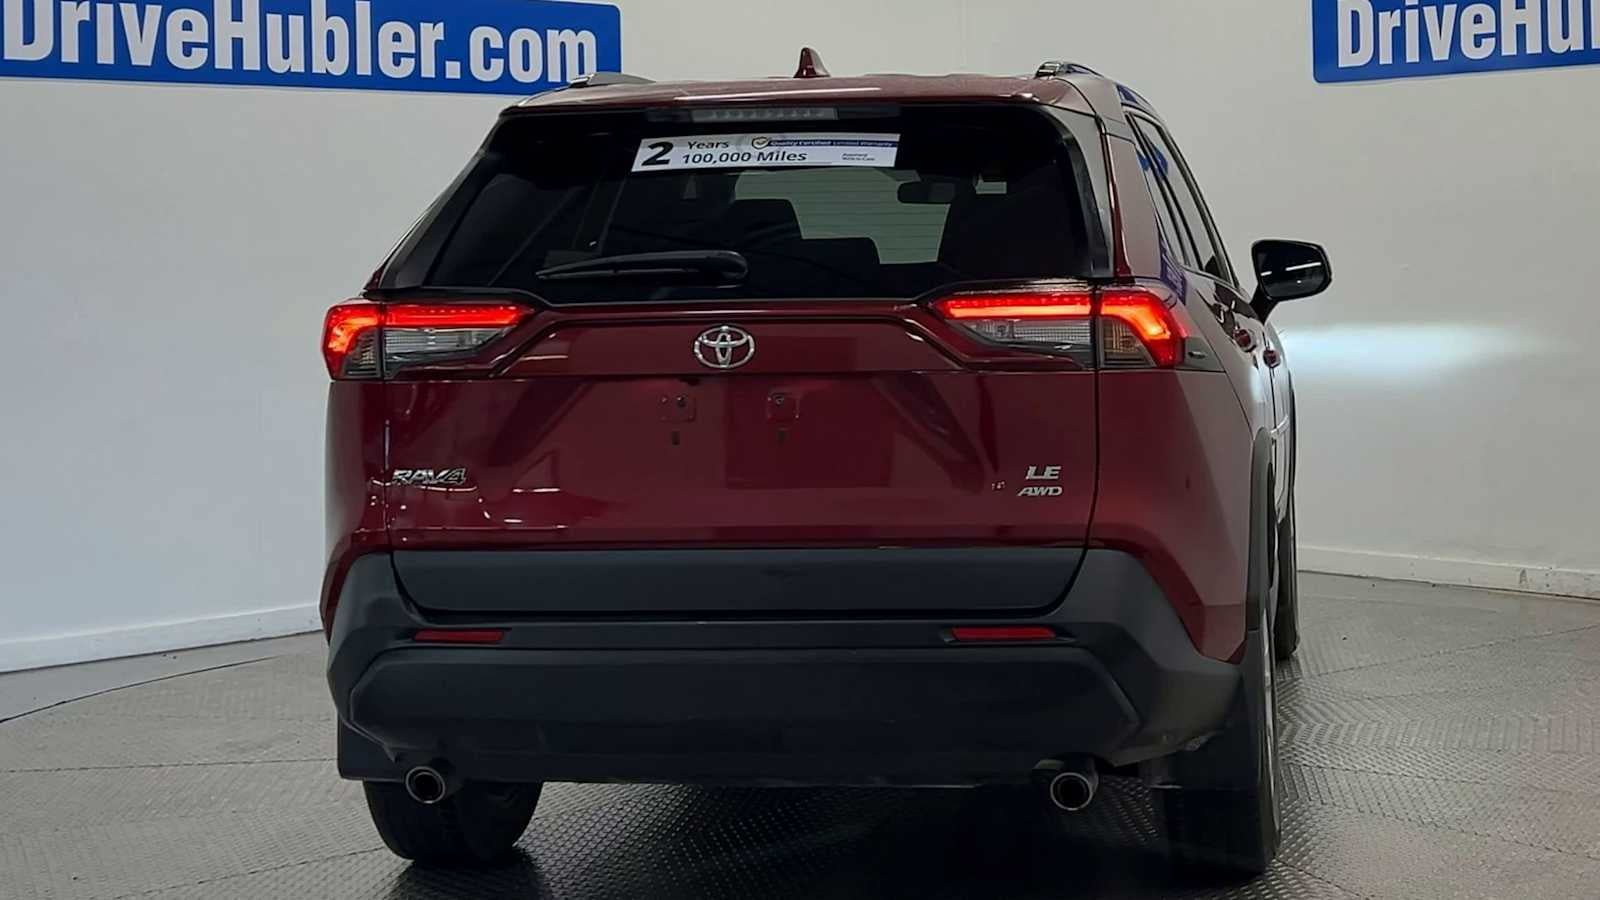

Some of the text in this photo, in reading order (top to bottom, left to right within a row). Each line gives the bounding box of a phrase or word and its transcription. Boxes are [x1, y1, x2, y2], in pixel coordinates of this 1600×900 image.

[3, 0, 597, 83] DriveHubler.com
[1337, 0, 1600, 68] DriveHu
[641, 141, 674, 166] 2
[688, 141, 729, 150] Years
[682, 150, 808, 164] 100,000 Miles
[391, 467, 467, 485] RAV4
[1025, 465, 1061, 480] LE
[1017, 486, 1063, 496] AWD
